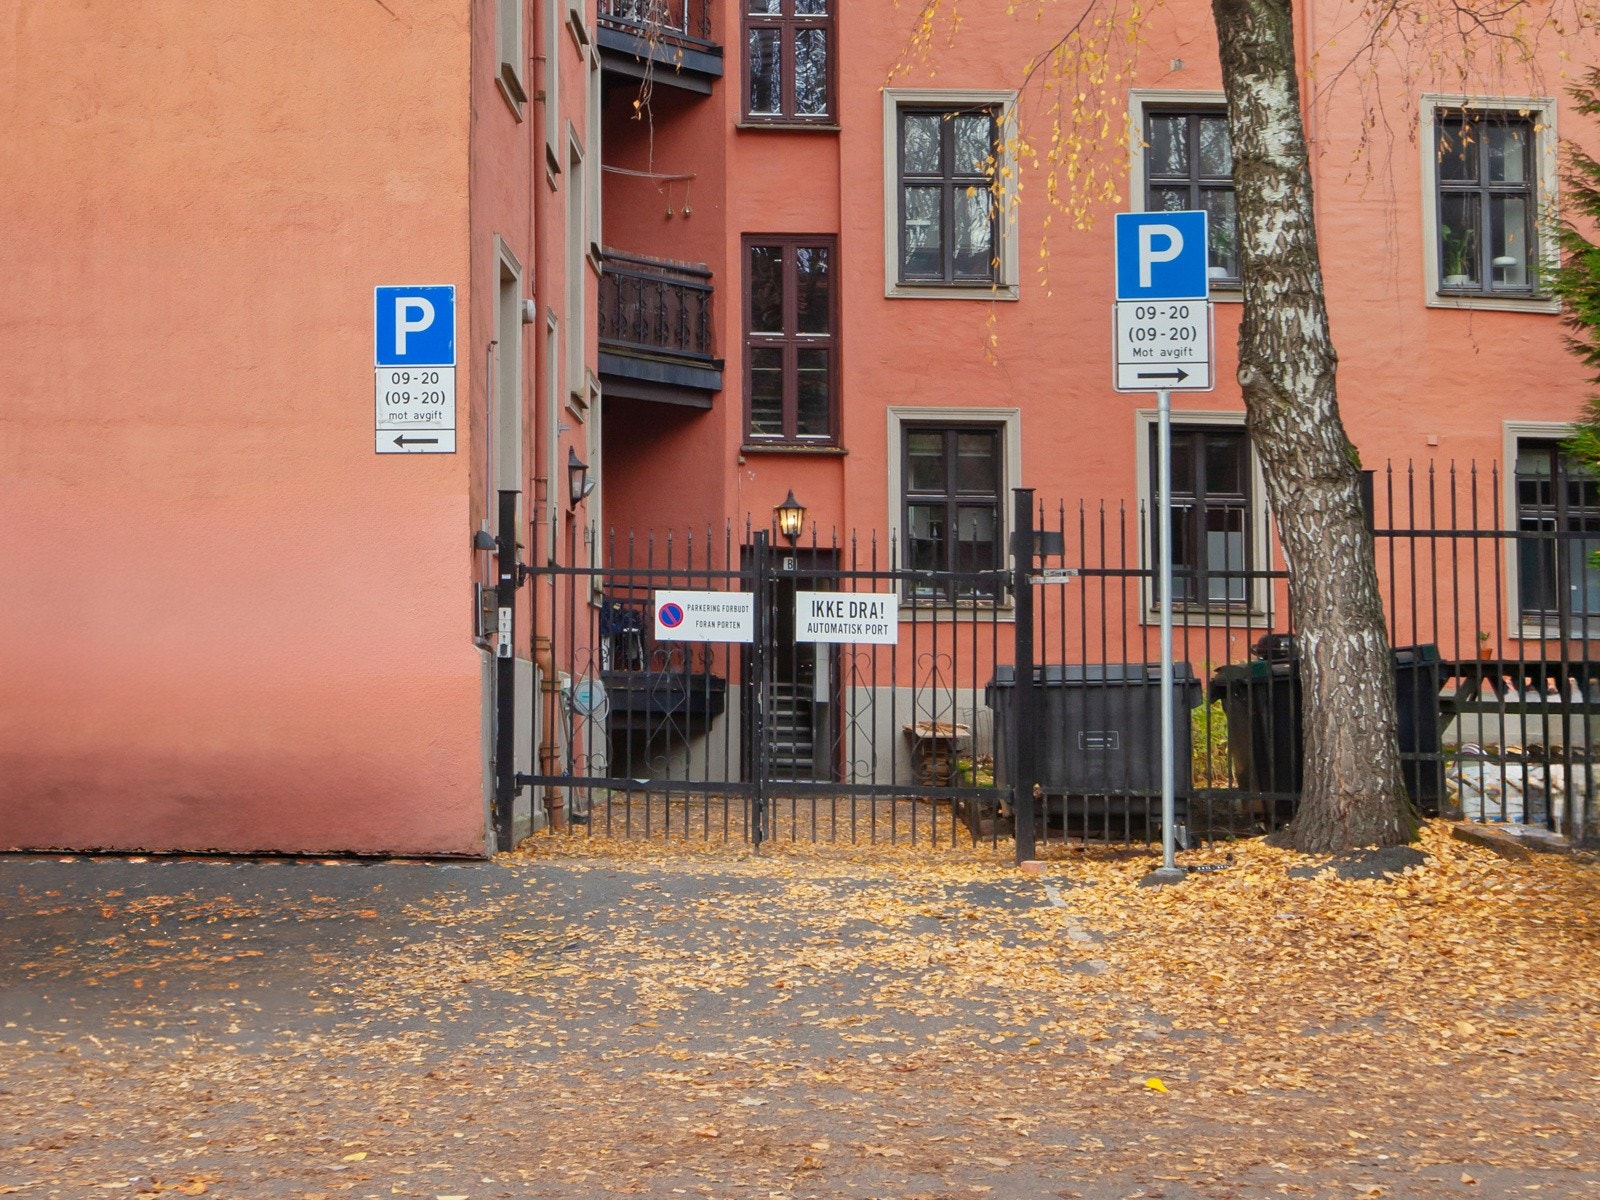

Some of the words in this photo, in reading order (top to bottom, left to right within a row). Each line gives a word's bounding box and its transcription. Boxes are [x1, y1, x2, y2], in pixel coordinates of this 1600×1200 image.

[1138, 224, 1184, 288] P
[395, 296, 435, 355] P
[1132, 347, 1153, 357] Mot
[1160, 346, 1193, 359] avgift
[388, 411, 408, 420] mot
[413, 410, 443, 422] avgift
[687, 603, 720, 613] PARKERING
[722, 604, 749, 613] FORBUDT
[811, 600, 844, 618] IKKE
[849, 601, 885, 619] DRA!
[695, 620, 716, 628] FORAN
[717, 621, 741, 629] PORTEN
[807, 622, 863, 635] AUTOMATISK
[865, 623, 888, 636] PORT
